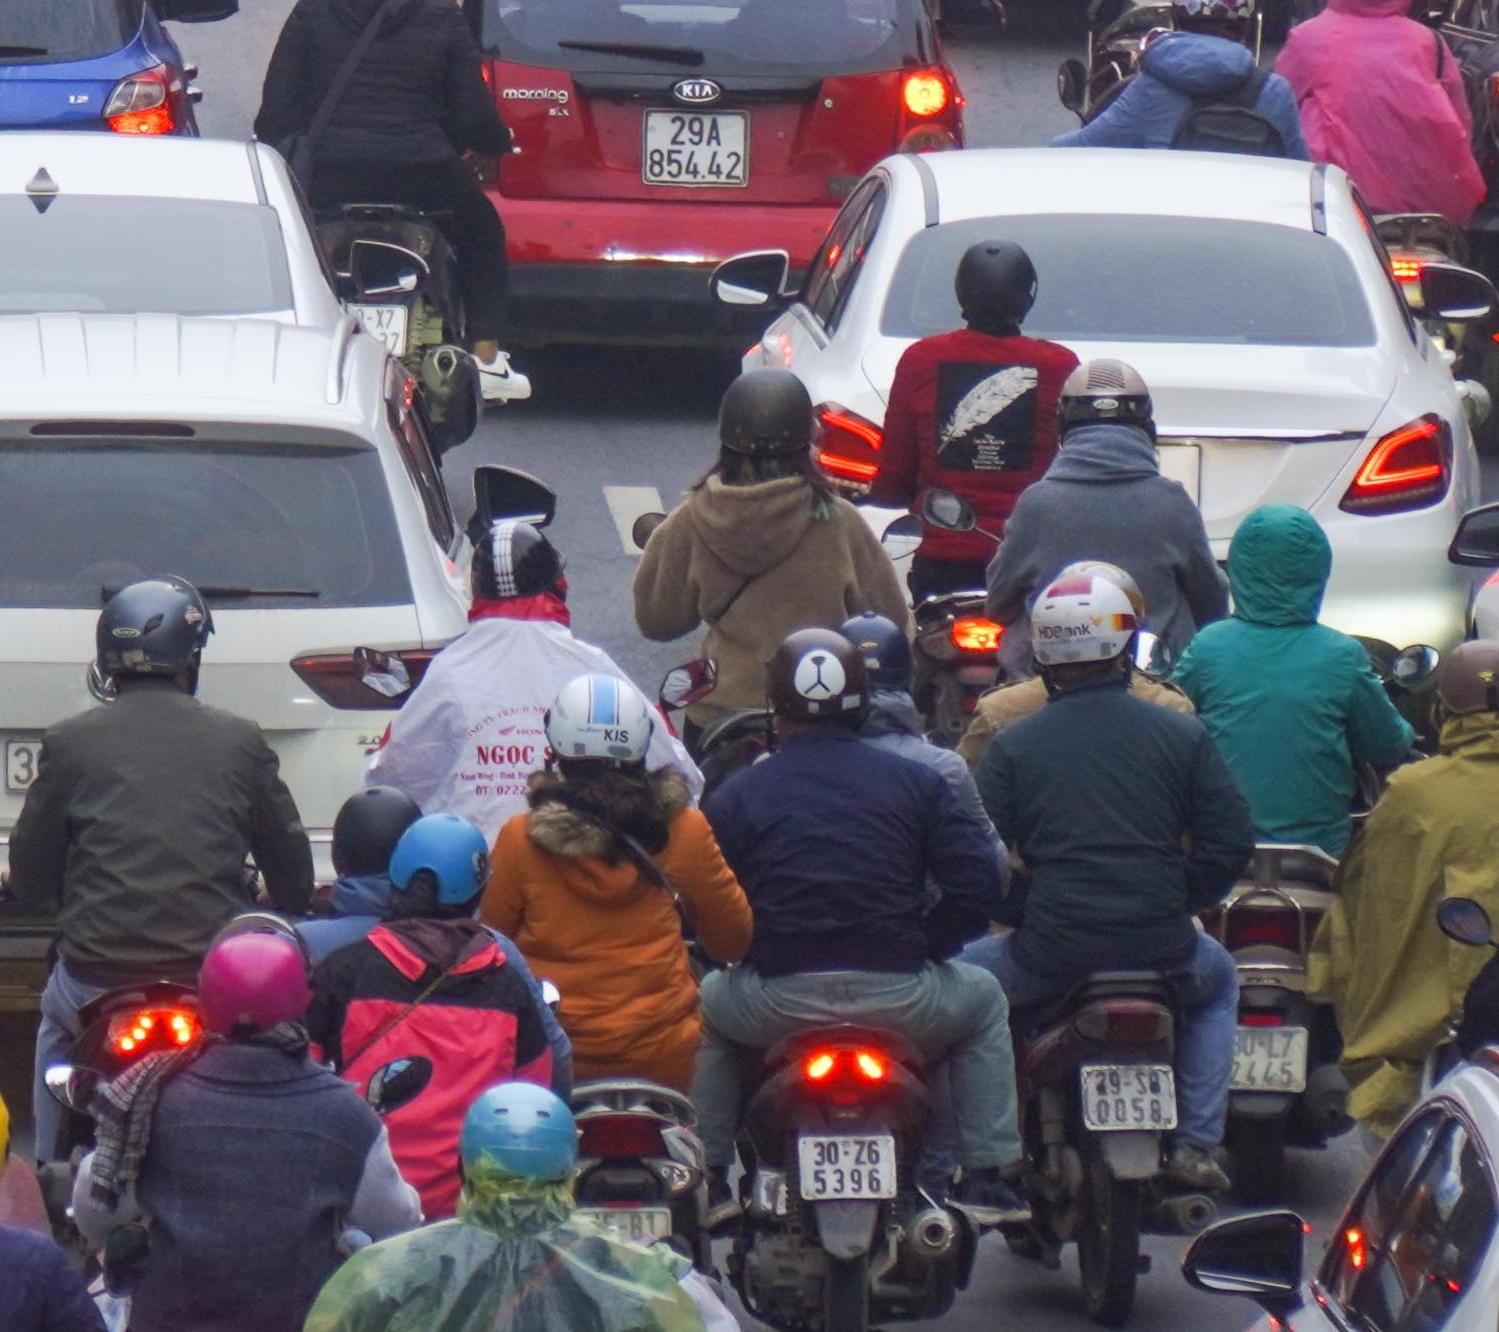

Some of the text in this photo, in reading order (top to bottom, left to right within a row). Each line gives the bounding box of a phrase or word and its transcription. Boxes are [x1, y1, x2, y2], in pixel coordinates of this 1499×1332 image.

[503, 88, 568, 103] morning
[682, 84, 712, 97] KIA
[671, 116, 722, 147] 29A
[648, 150, 742, 181] 854.42
[604, 729, 629, 743] KIS
[476, 745, 535, 768] NGỌC
[1095, 1098, 1162, 1124] 0058
[814, 1140, 880, 1166] 30-Z6
[814, 1168, 881, 1195] 5396
